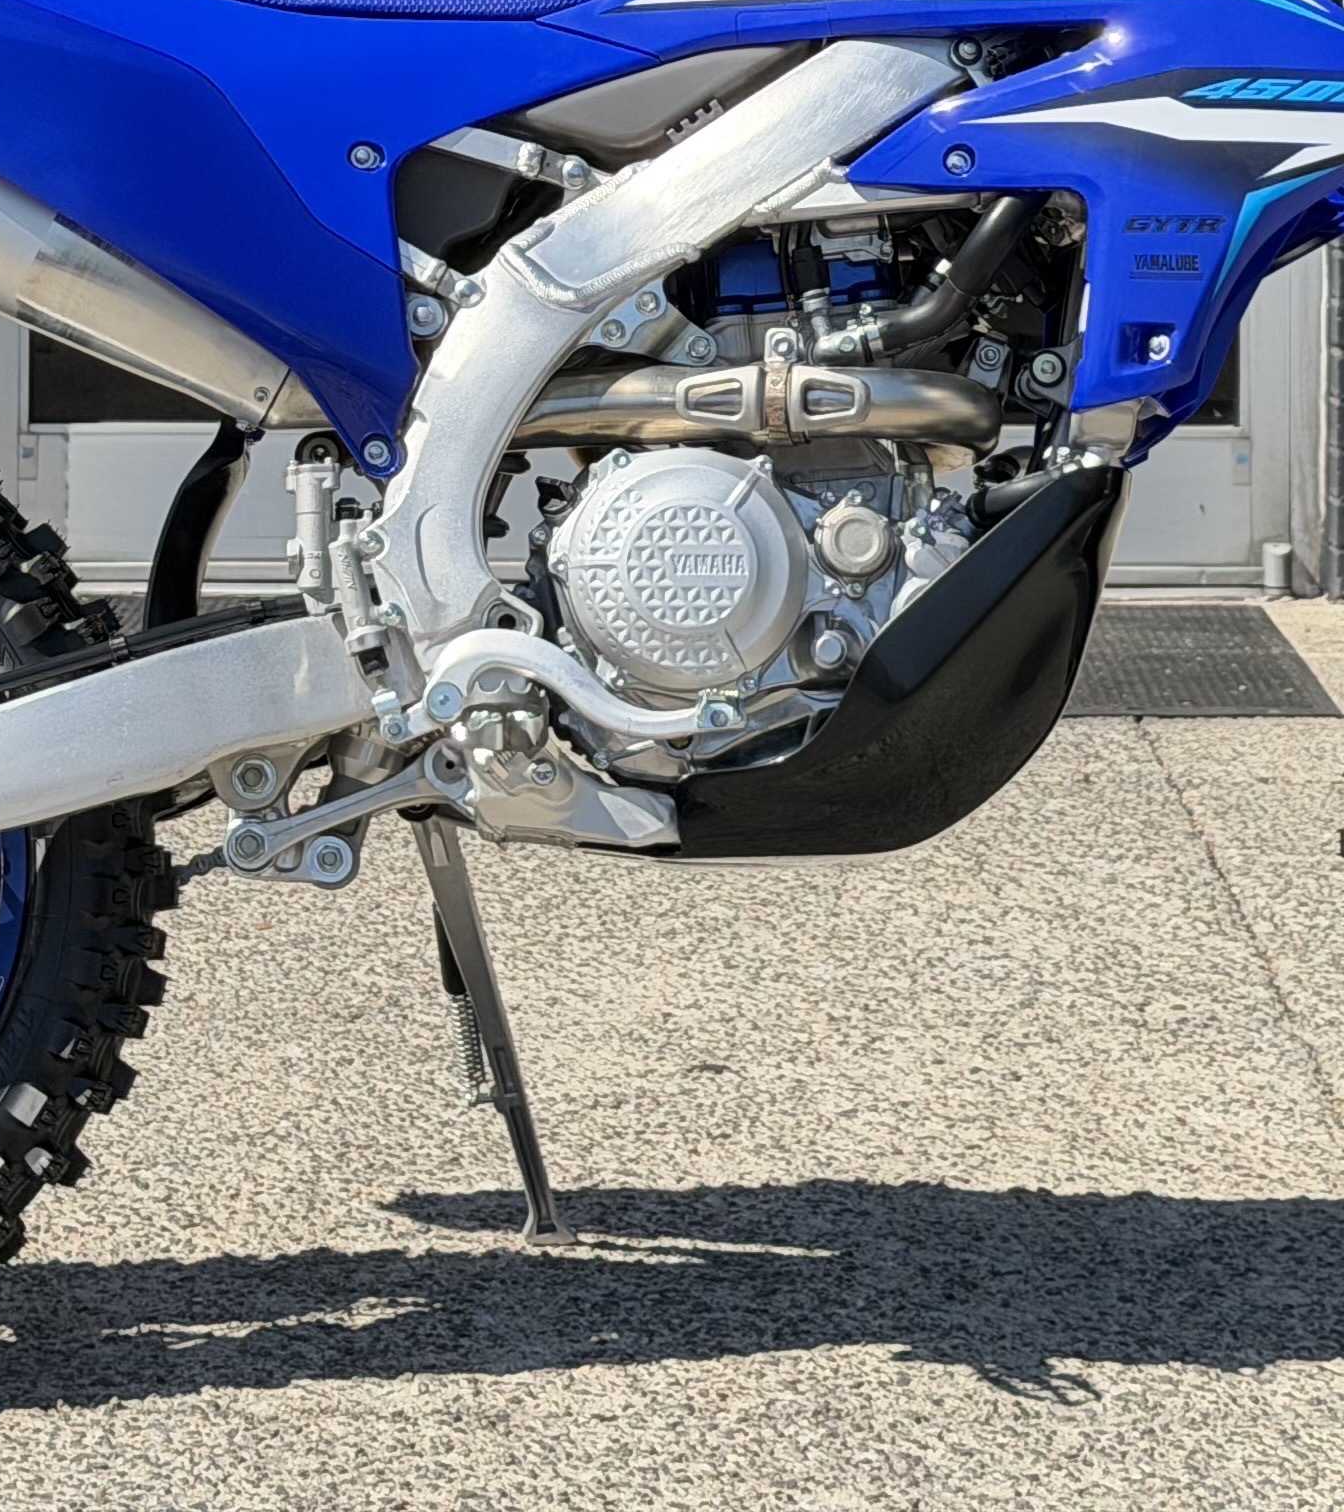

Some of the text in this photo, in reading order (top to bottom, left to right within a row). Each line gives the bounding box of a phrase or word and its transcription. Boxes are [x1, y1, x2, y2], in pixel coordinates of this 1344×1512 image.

[1122, 214, 1228, 235] GYTR
[1133, 254, 1200, 273] YAMALUBE
[671, 553, 748, 576] YAMAHA
